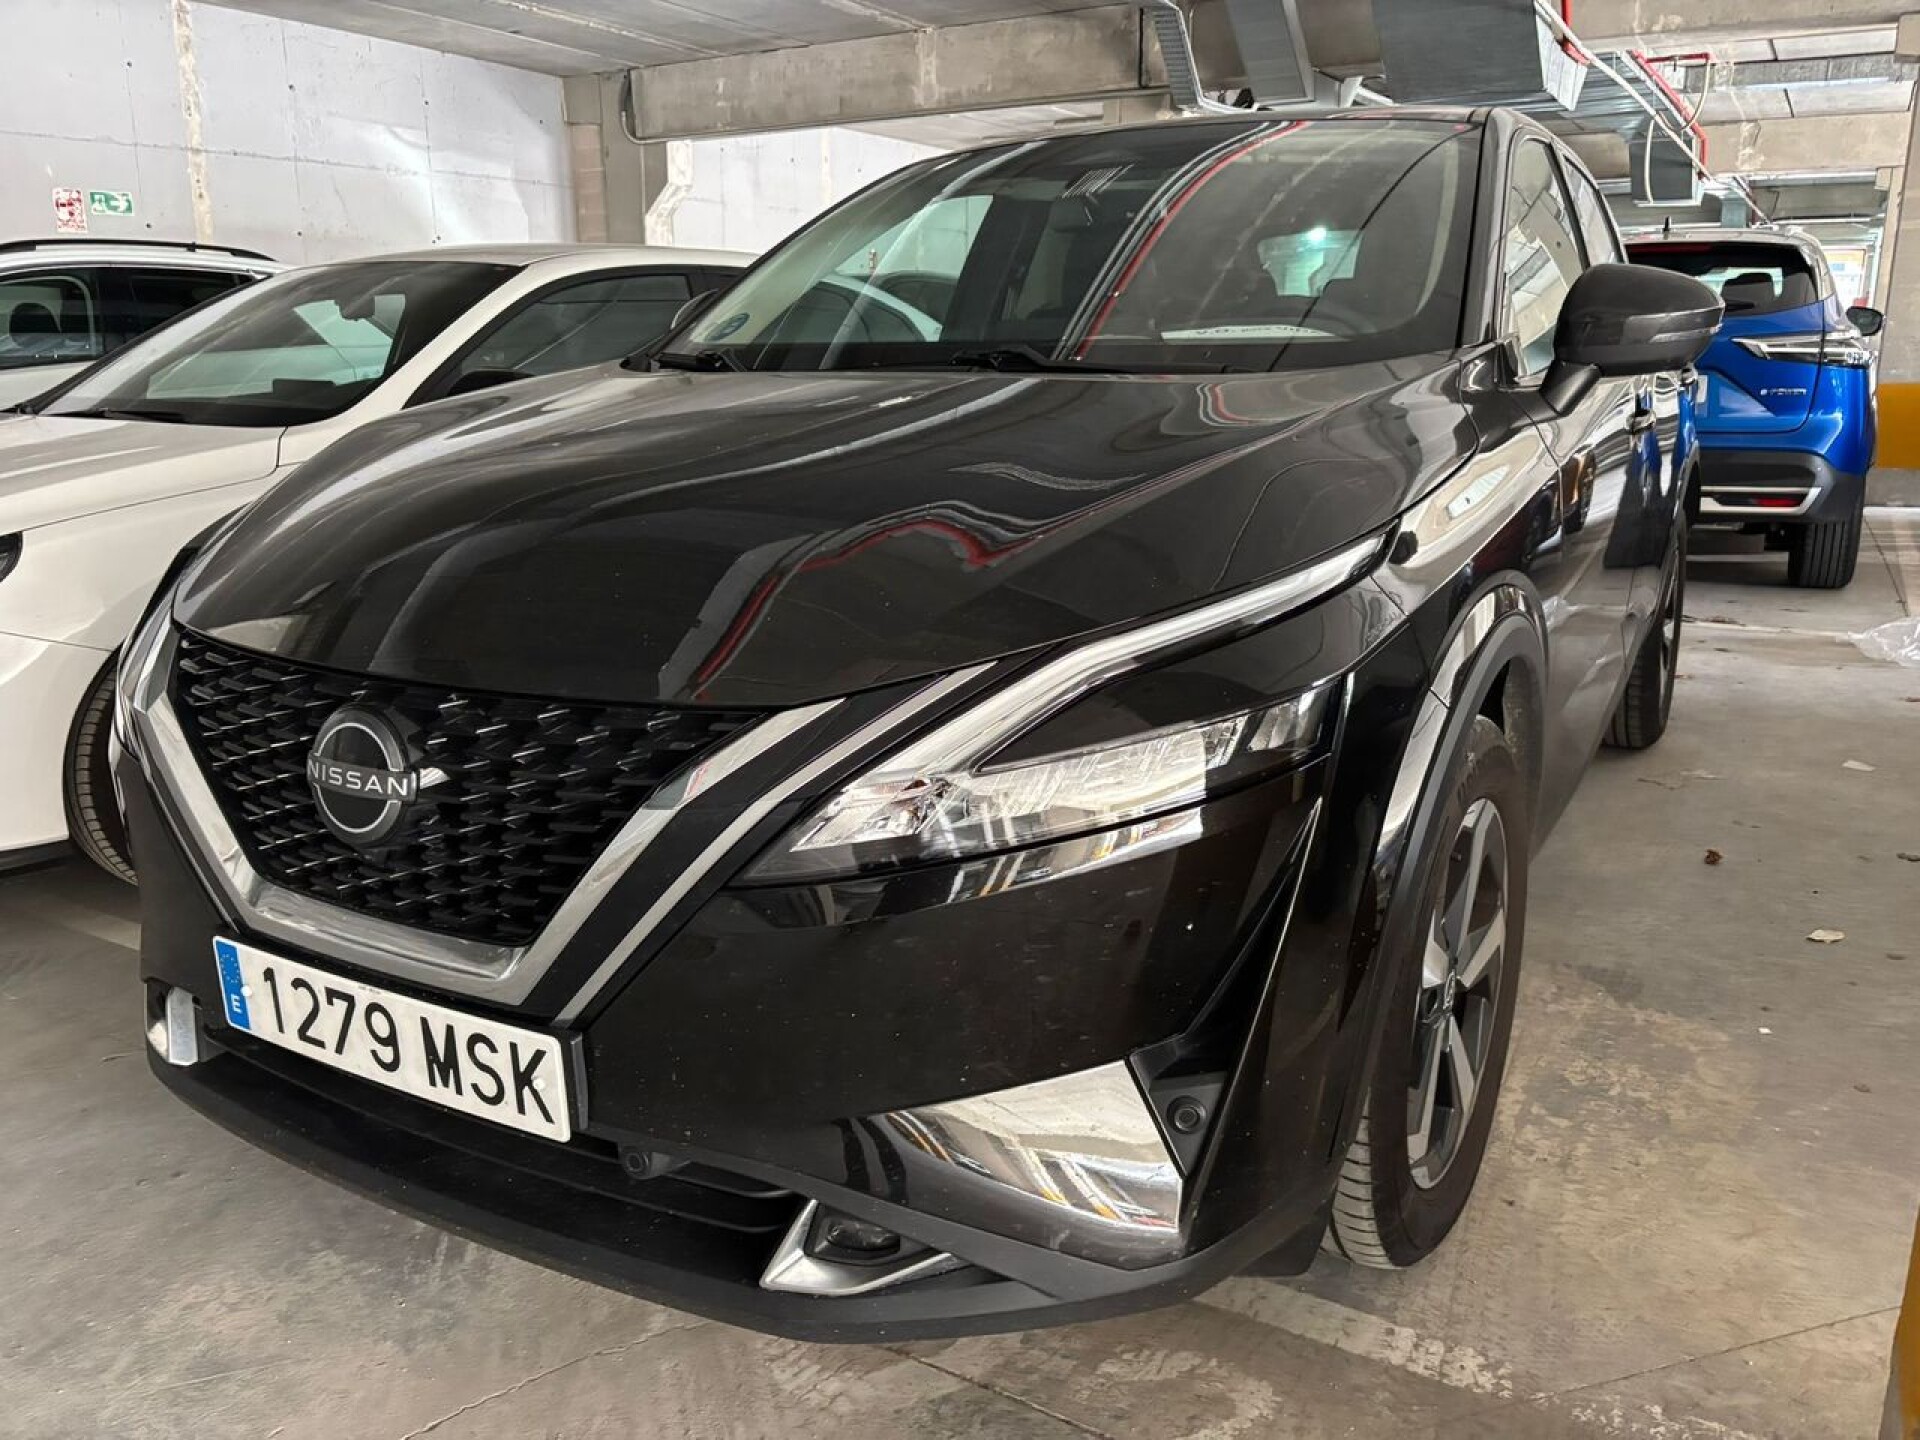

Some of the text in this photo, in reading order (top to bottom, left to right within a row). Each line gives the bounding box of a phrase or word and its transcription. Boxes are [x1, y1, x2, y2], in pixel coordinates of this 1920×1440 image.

[307, 758, 409, 797] NISSAN
[230, 994, 243, 1014] E
[263, 967, 555, 1125] 1279 MSK
